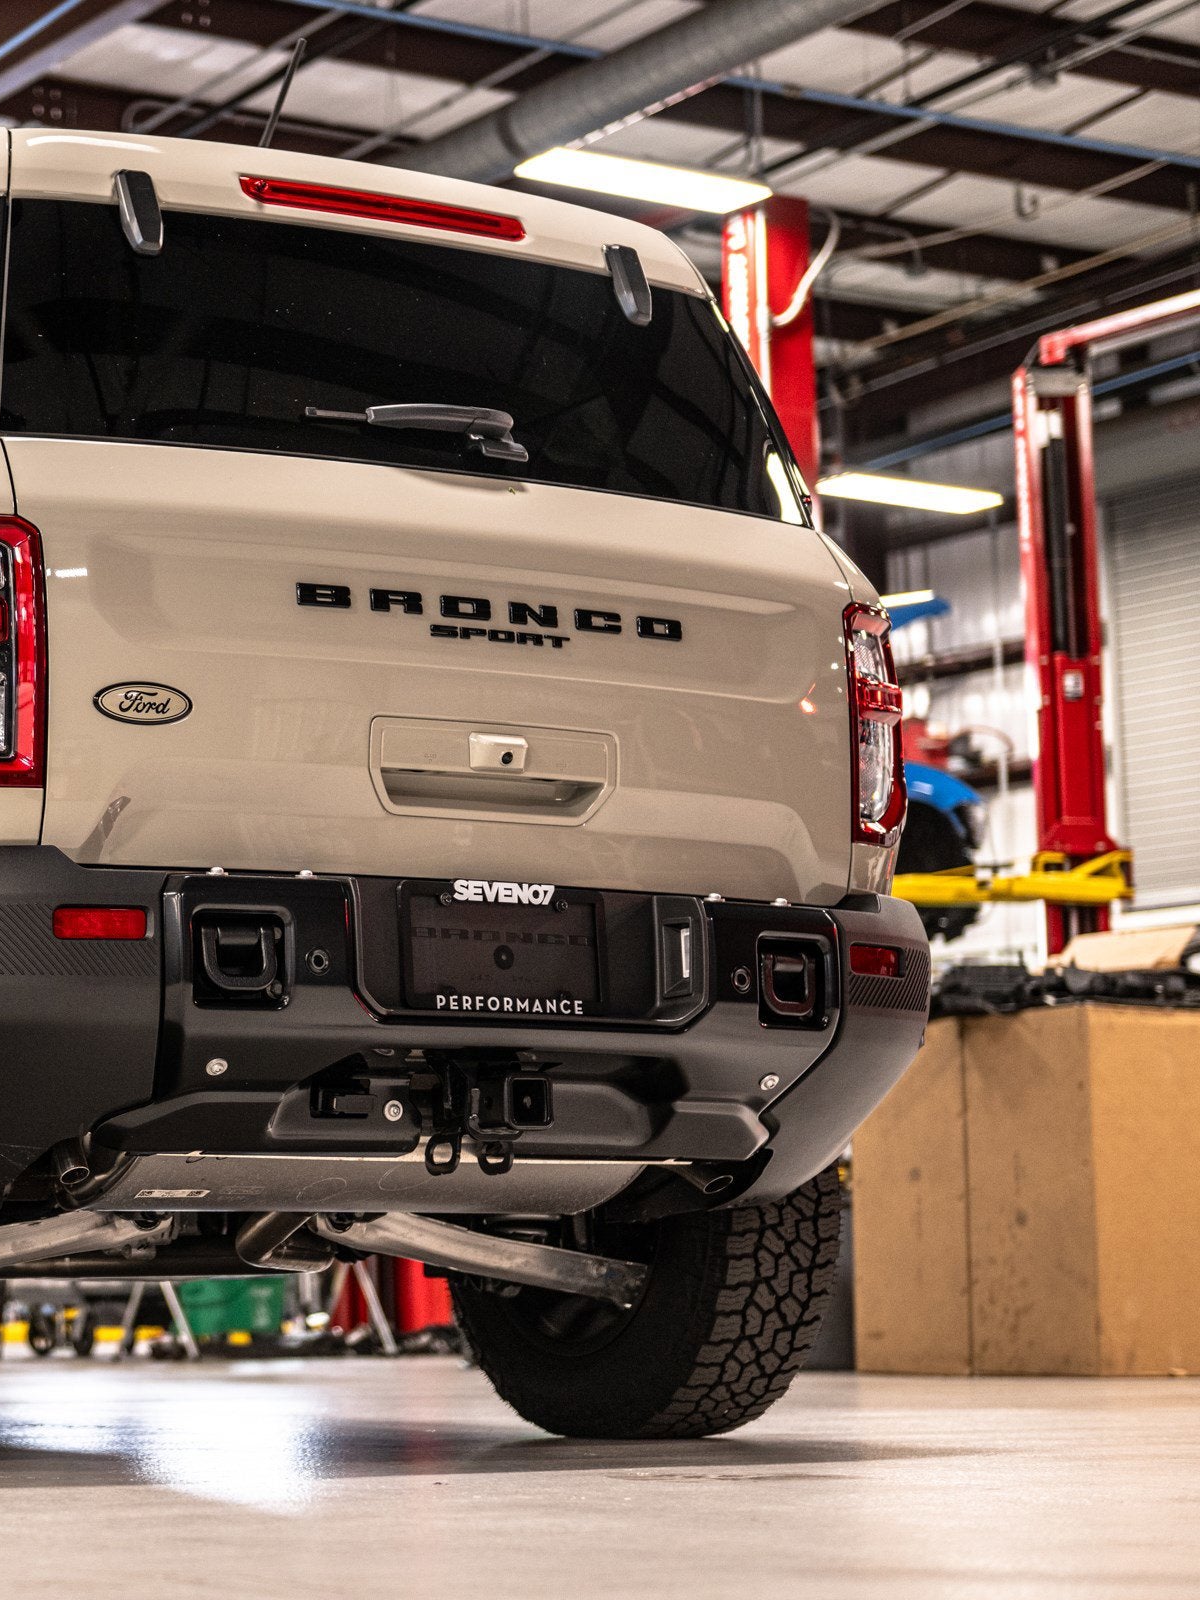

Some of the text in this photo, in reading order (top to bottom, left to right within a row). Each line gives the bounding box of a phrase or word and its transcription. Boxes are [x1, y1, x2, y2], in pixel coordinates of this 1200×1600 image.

[295, 581, 683, 642] BRONCO
[429, 623, 571, 648] SPORT
[118, 689, 172, 715] Ford
[435, 994, 584, 1015] PERFORMANCE
